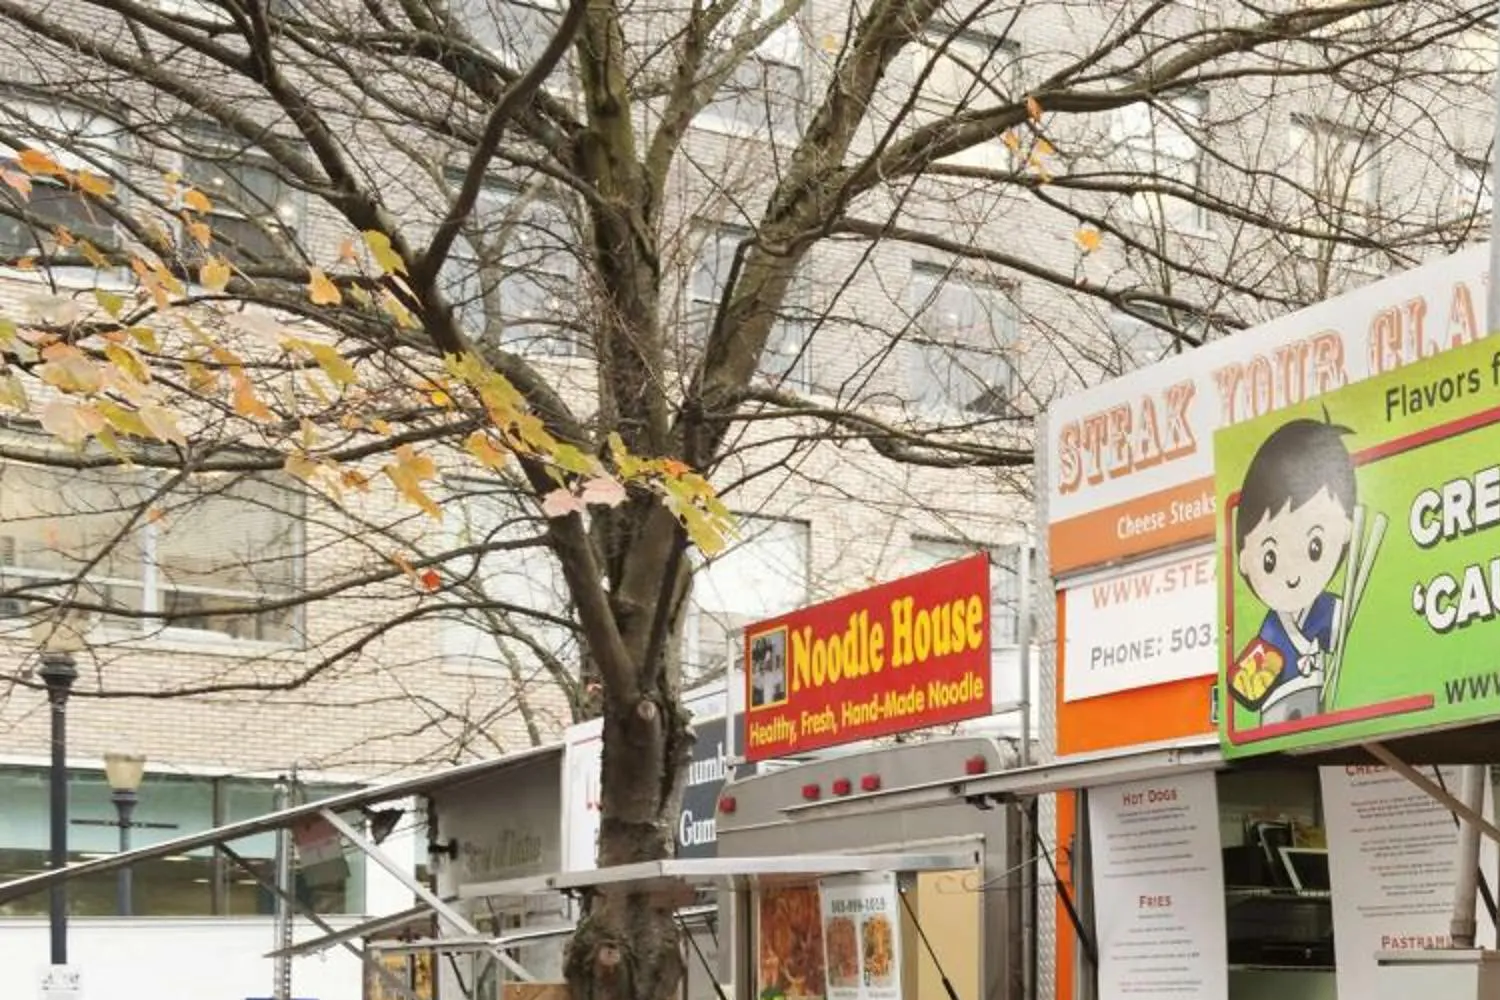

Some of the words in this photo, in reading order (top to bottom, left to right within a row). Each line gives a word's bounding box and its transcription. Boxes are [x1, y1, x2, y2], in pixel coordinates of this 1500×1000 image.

[1058, 377, 1196, 494] STEAK
[1211, 330, 1348, 424] YOUR
[1386, 367, 1481, 422] Flavors
[1117, 509, 1165, 539] Cheese
[1092, 560, 1216, 610] WWW.STE
[791, 610, 884, 692] Noodle
[891, 595, 983, 667] House
[1090, 635, 1163, 670] PHONE:
[750, 715, 797, 746] Healthy,
[801, 704, 837, 736] Fresh,
[841, 684, 925, 727] Hand-Made
[929, 672, 983, 709] Noodle
